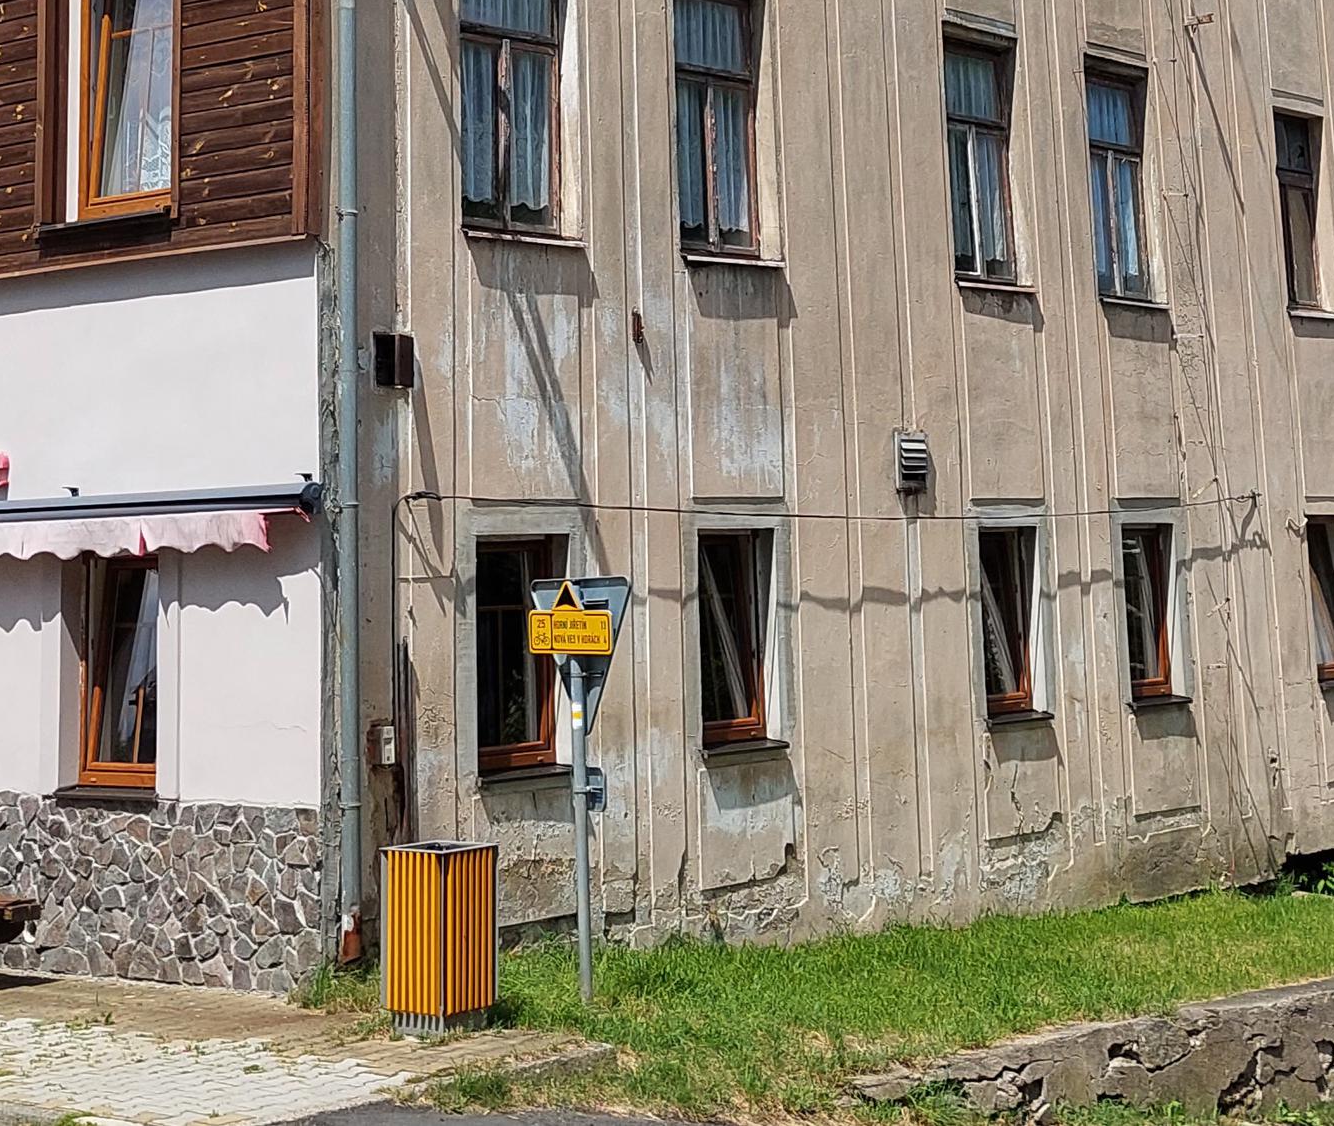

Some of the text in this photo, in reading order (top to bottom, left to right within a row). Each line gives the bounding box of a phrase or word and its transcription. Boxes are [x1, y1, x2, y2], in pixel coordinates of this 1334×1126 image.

[537, 619, 546, 629] 25
[553, 618, 568, 629] HORNÍ
[569, 618, 587, 630] JIŘETÍN
[554, 633, 566, 643] NOVÁ
[581, 633, 600, 644] HORÁCH
